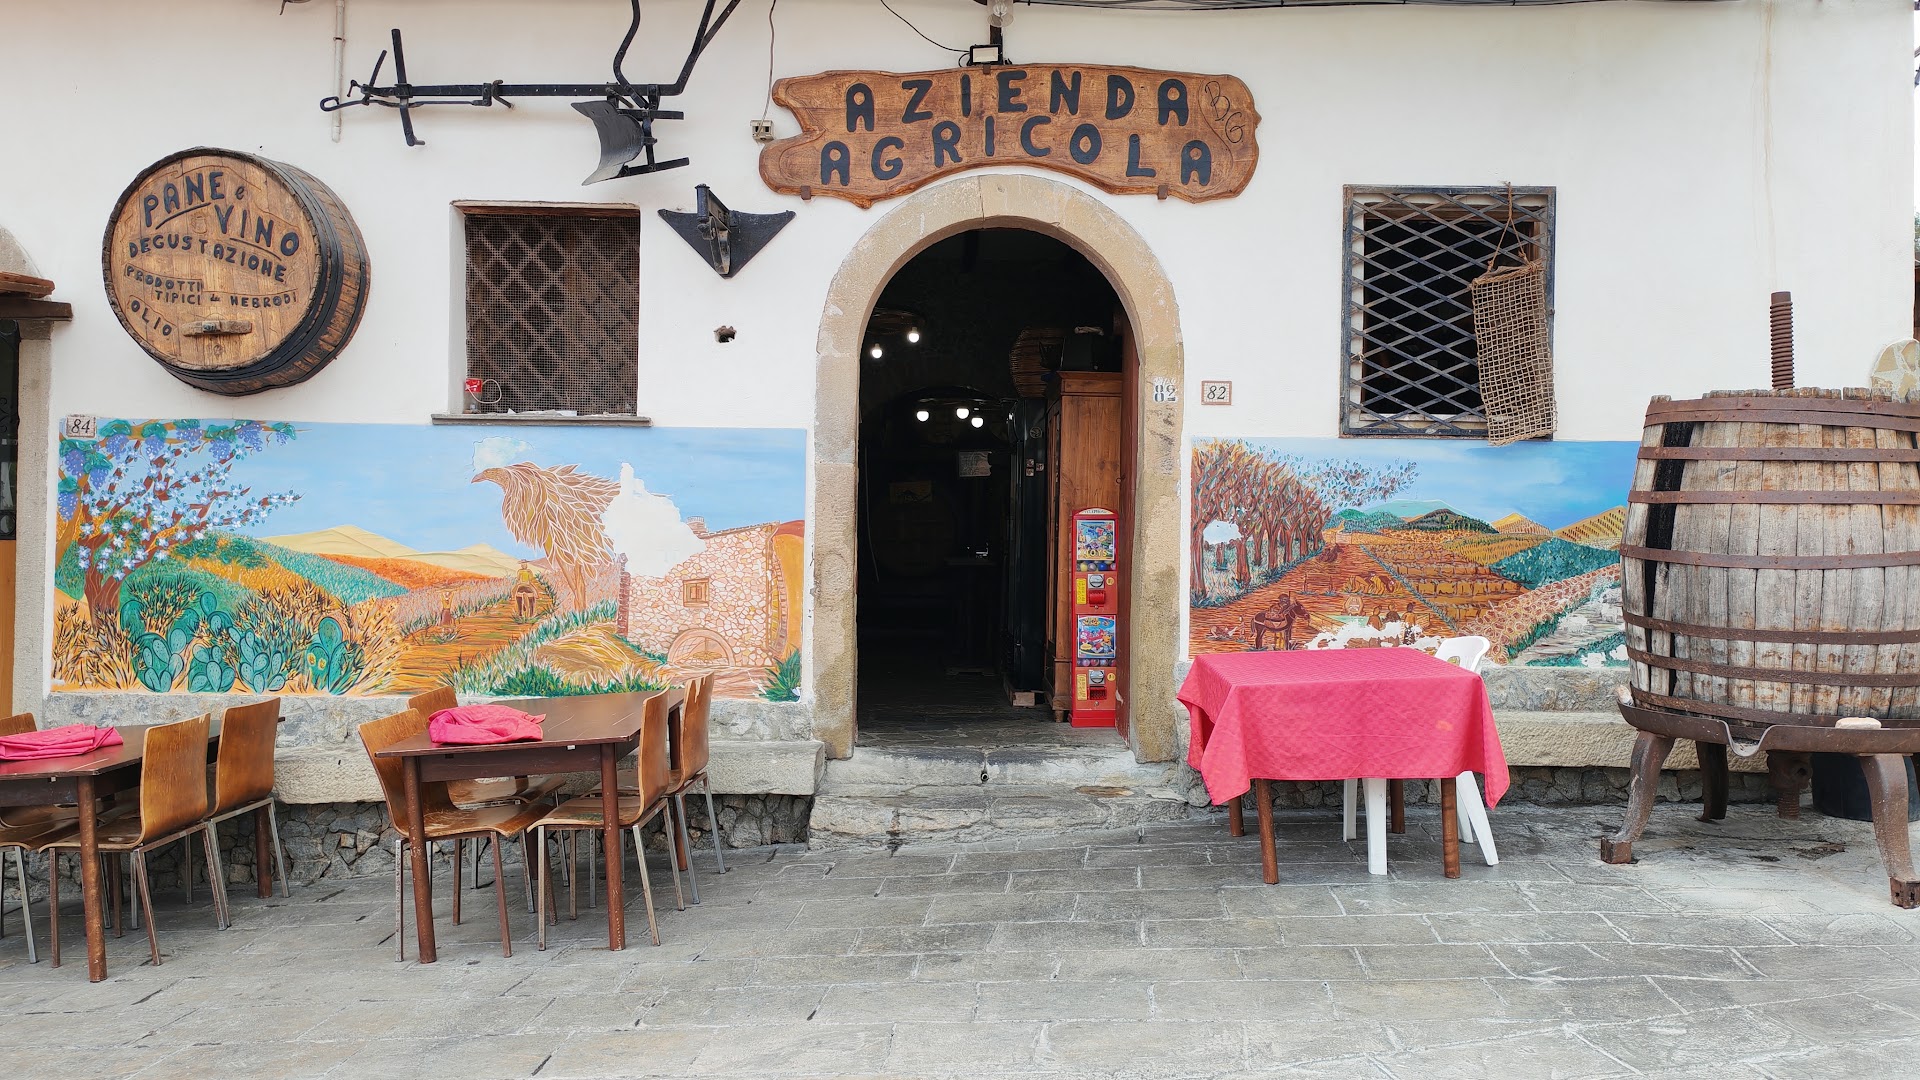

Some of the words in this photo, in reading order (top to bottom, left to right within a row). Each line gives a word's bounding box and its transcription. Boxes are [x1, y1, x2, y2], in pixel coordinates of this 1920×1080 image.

[846, 70, 1189, 132] AZIENDA
[820, 115, 1212, 187] AGRICOLA
[143, 171, 226, 228] PANE
[234, 185, 246, 201] e
[214, 204, 300, 257] VINO
[128, 233, 287, 283] DEGUSTAZIONE
[126, 265, 203, 293] PRODOTTI
[154, 290, 202, 306] TIPICI
[130, 299, 173, 337] OLIO
[1154, 384, 1176, 402] 82
[1206, 385, 1227, 400] 82
[71, 418, 91, 434] 84
